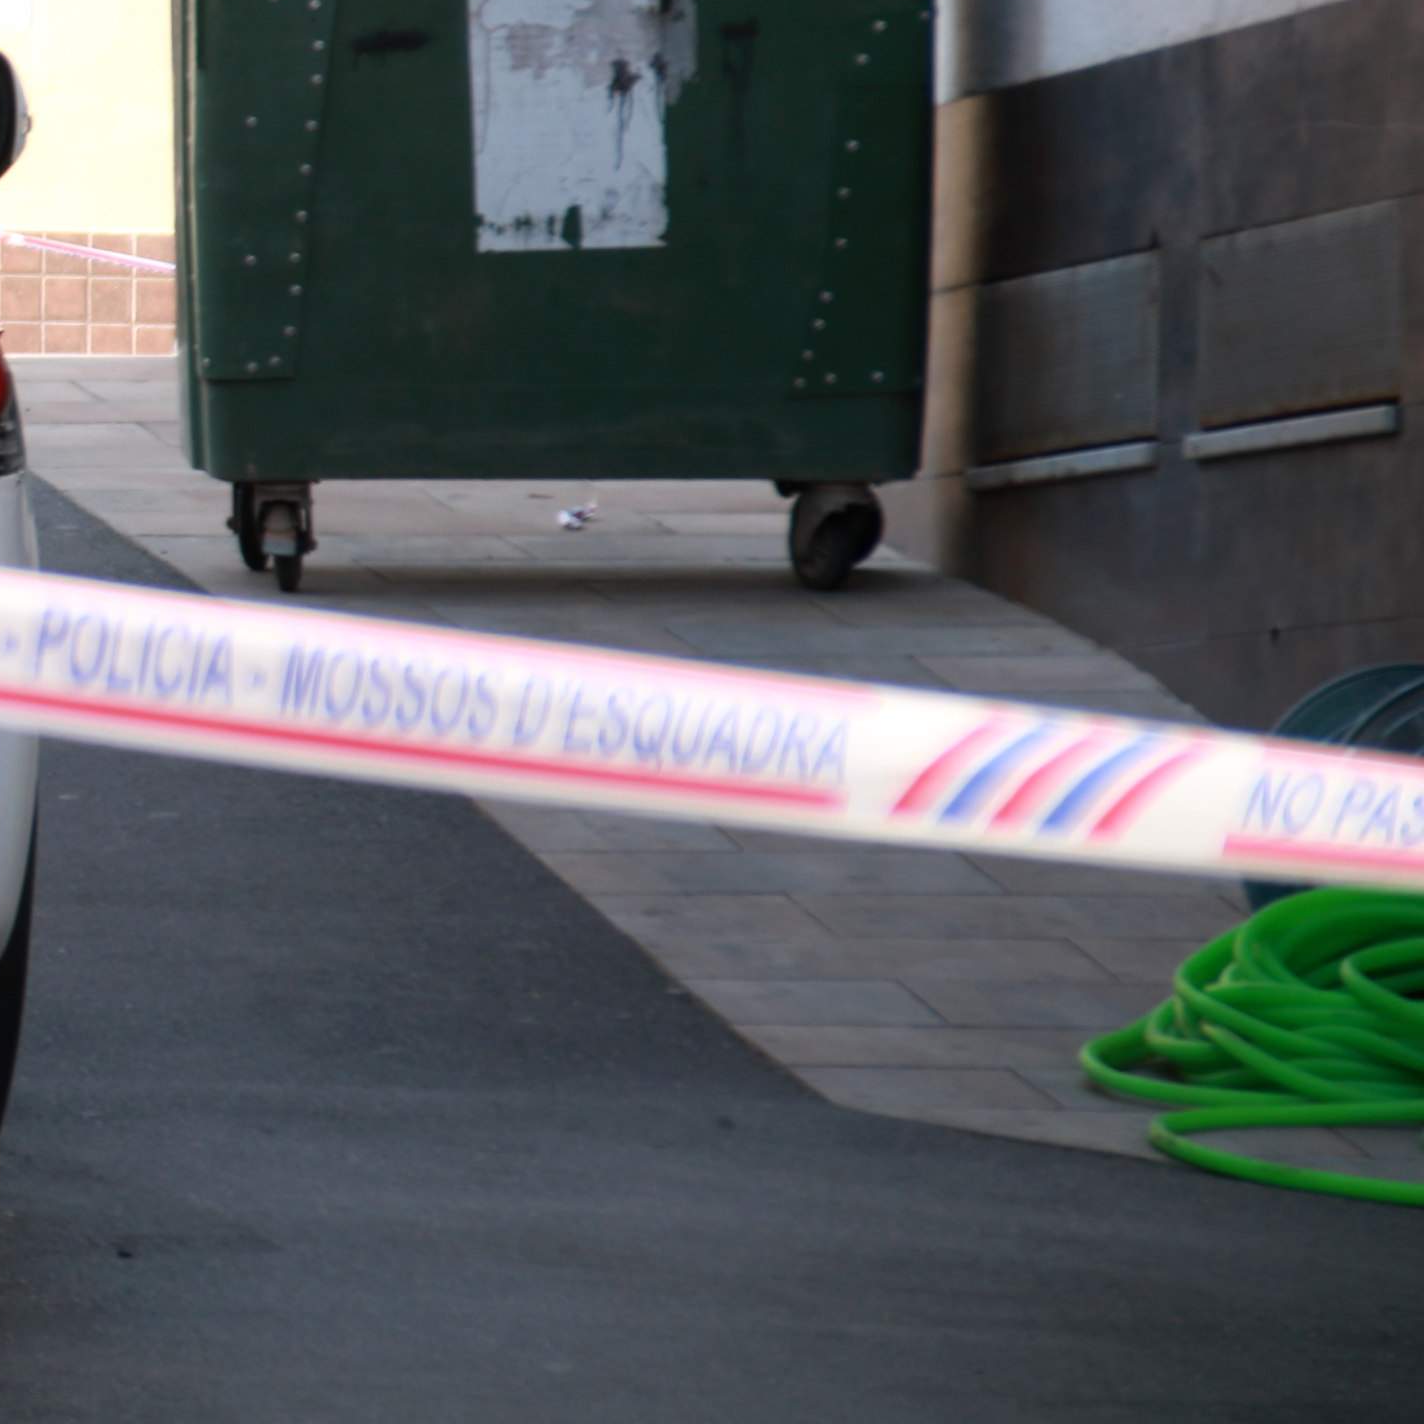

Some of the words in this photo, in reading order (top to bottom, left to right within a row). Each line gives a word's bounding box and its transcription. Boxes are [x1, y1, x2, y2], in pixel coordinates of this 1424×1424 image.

[32, 604, 233, 710] POLICIA
[279, 644, 499, 743] MOSSOS
[512, 674, 849, 786] D'ESQUADRA
[1242, 769, 1326, 834] NO
